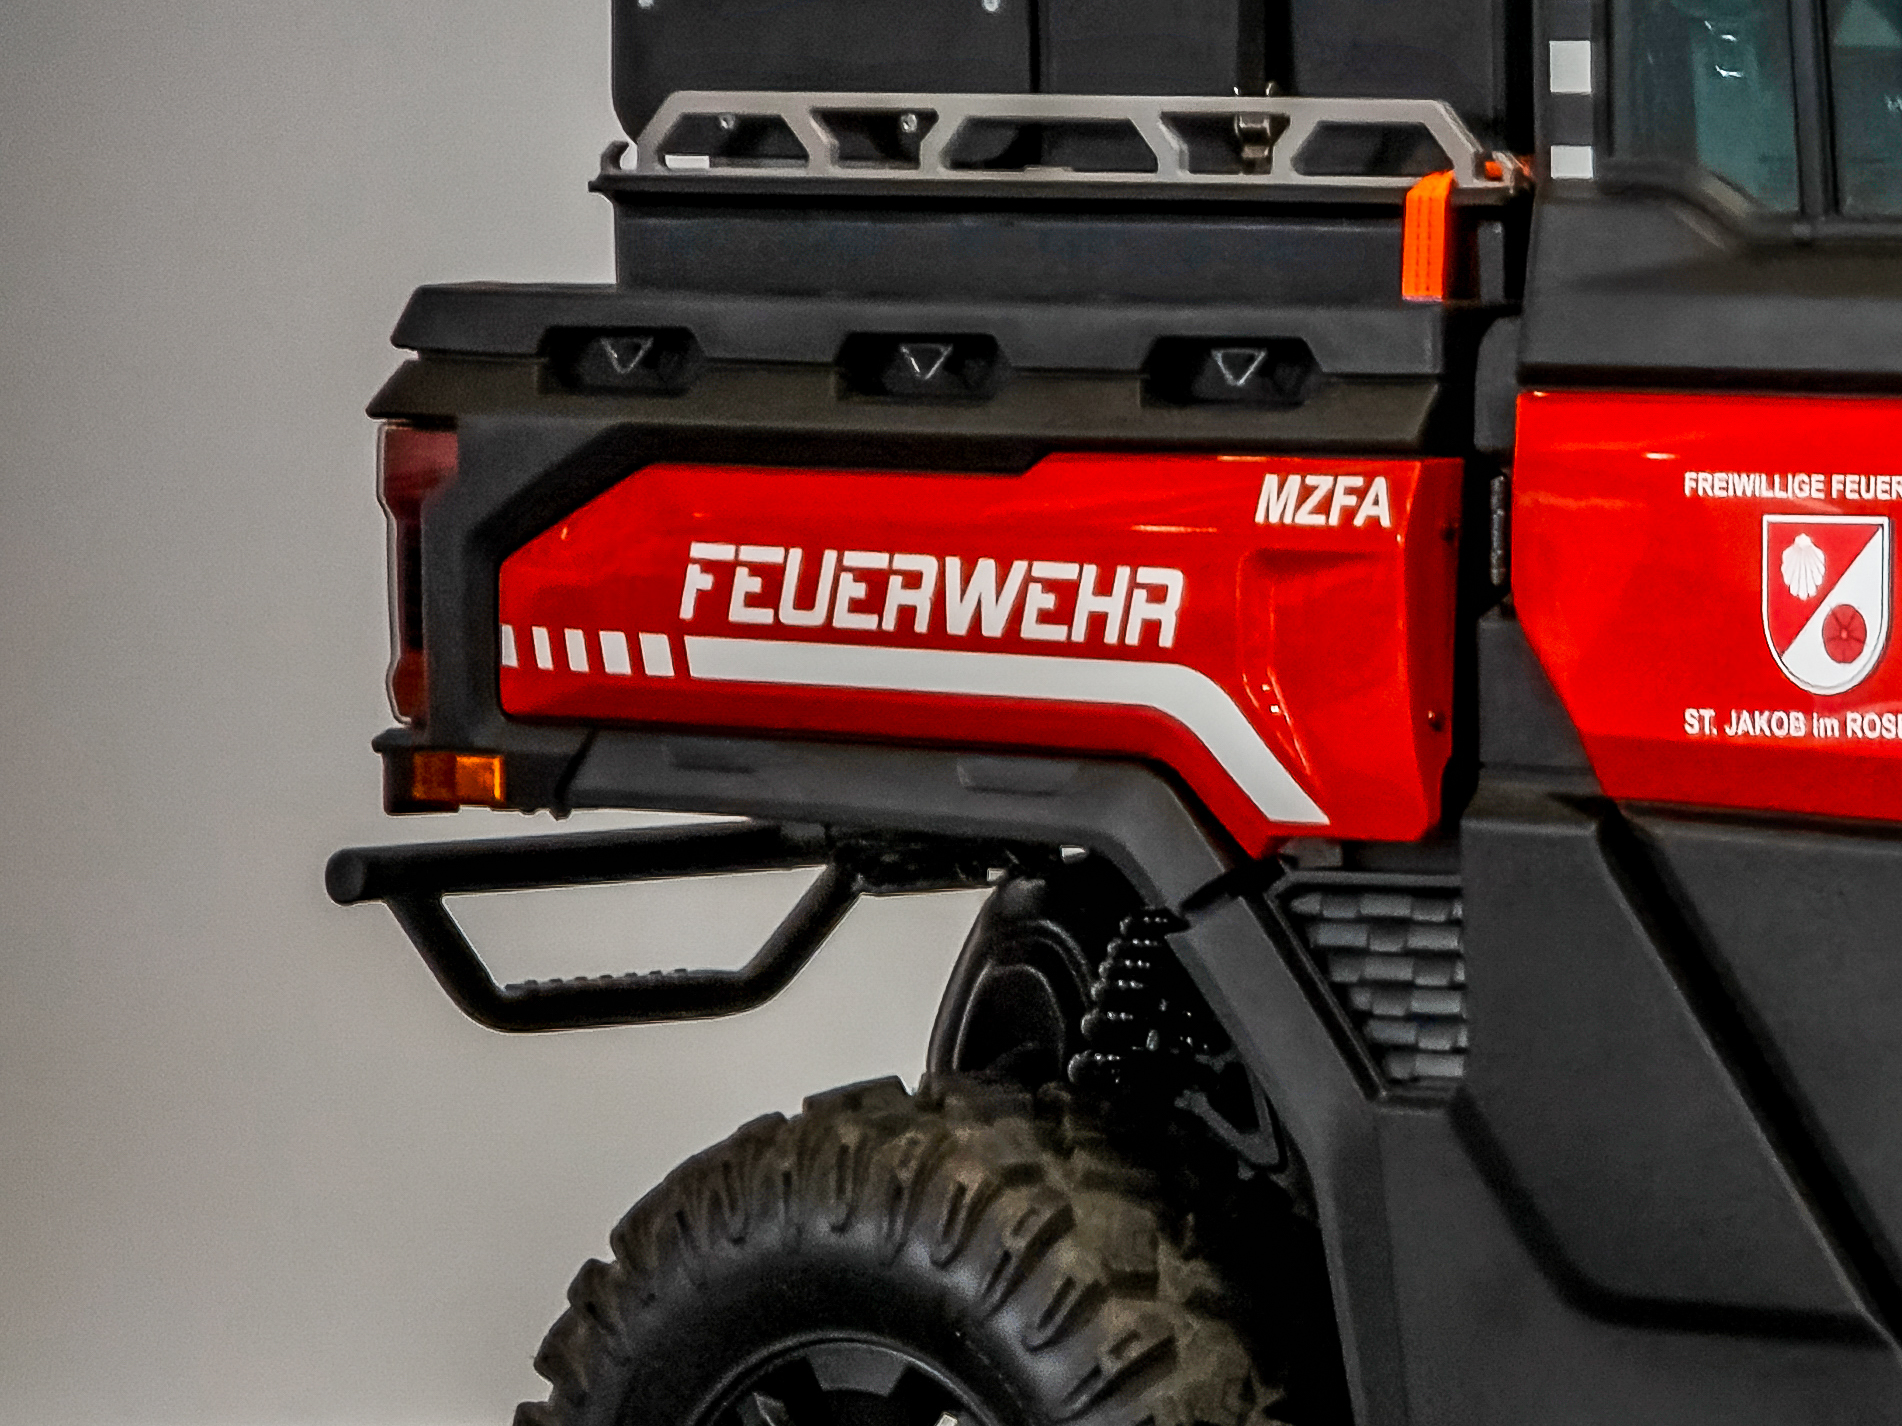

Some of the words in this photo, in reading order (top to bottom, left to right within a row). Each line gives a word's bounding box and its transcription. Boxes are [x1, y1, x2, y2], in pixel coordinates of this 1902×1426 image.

[1256, 473, 1392, 530] MZFA
[1684, 471, 1825, 499] FREIWILLIGE
[679, 541, 1184, 649] FEUERWEHR
[1683, 708, 1717, 737] ST.
[1723, 709, 1806, 738] JAKOB
[1812, 712, 1839, 738] im
